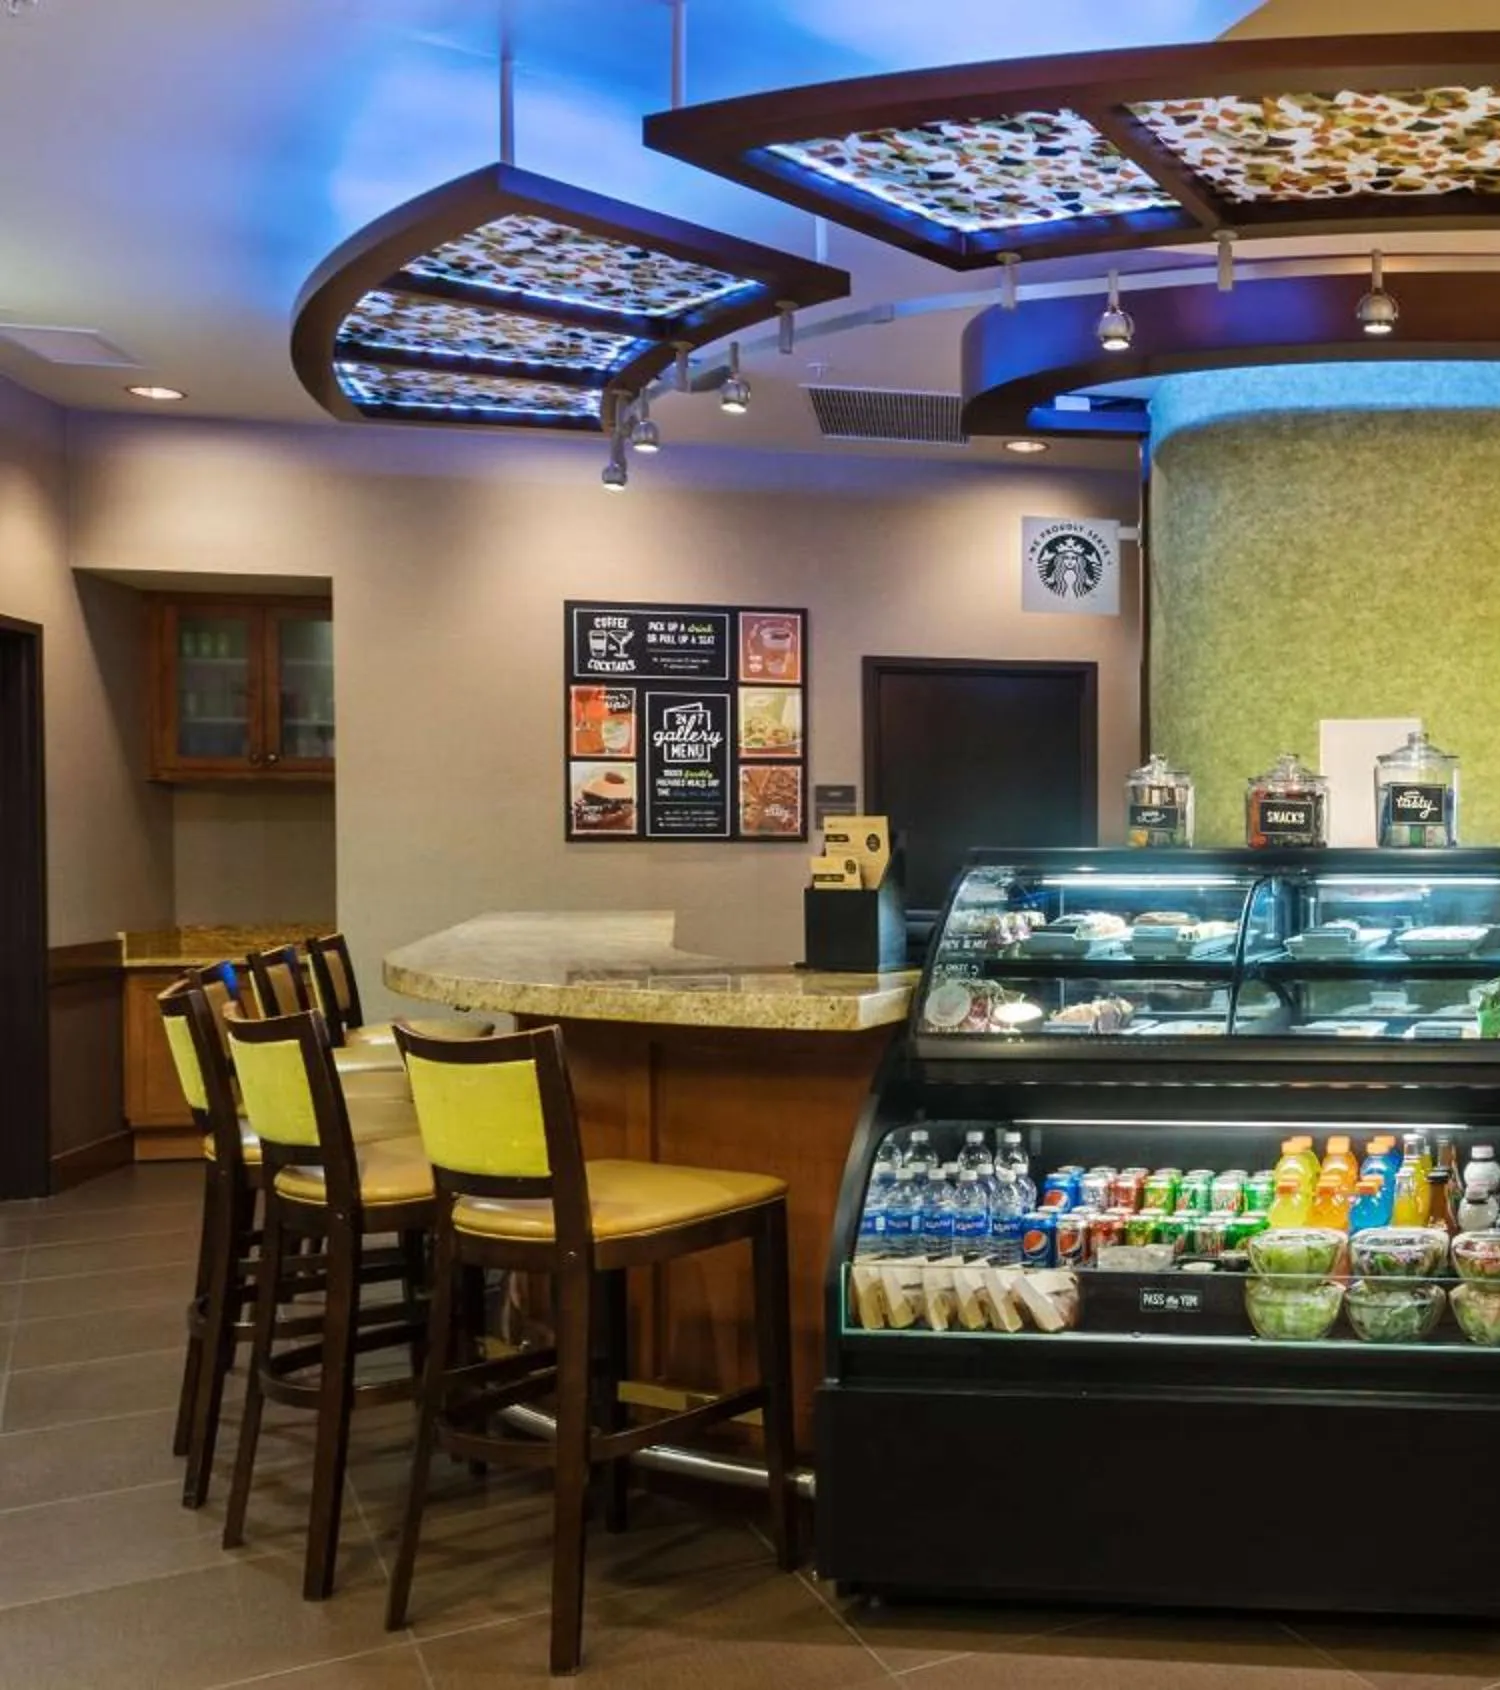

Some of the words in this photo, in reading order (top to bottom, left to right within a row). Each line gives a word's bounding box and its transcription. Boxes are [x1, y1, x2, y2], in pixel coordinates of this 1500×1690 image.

[1040, 523, 1084, 538] PROUDLY
[1087, 529, 1111, 556] SERVE
[594, 617, 629, 629] COFFEE
[648, 621, 665, 631] PICK
[667, 621, 678, 631] UP
[587, 658, 637, 671] COCKTAILS
[653, 714, 723, 747] gallery
[671, 743, 705, 758] MENU
[1396, 795, 1439, 819] tasty
[1266, 811, 1305, 825] SNACKS
[1143, 1293, 1165, 1305] PASS
